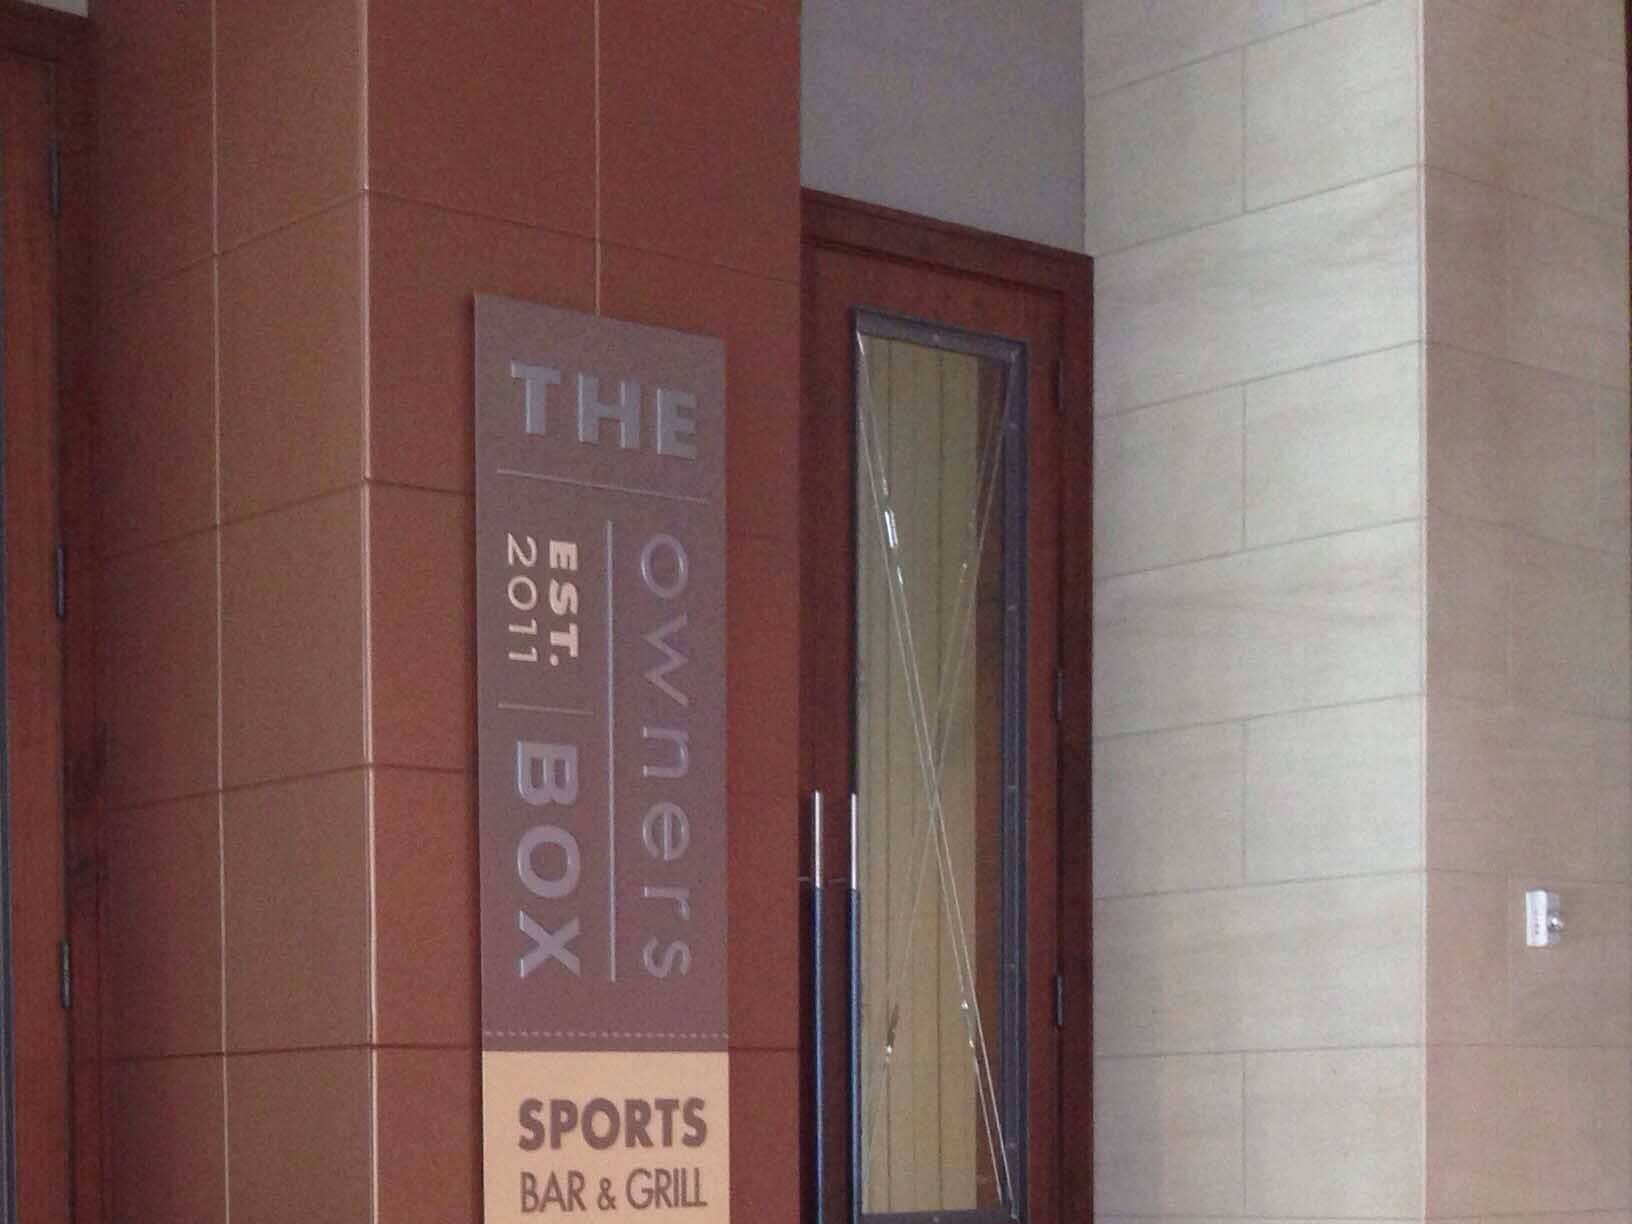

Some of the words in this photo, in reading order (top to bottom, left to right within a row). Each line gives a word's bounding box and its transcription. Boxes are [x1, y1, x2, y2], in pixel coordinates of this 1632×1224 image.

[510, 358, 697, 461] THE
[507, 533, 538, 665] 2011
[549, 540, 579, 667] EST.
[640, 534, 692, 978] owners
[516, 741, 581, 979] BOX
[517, 1096, 708, 1151] SPORTS
[520, 1170, 586, 1214] BAR
[597, 1180, 616, 1210] &
[625, 1167, 708, 1209] GRILL
